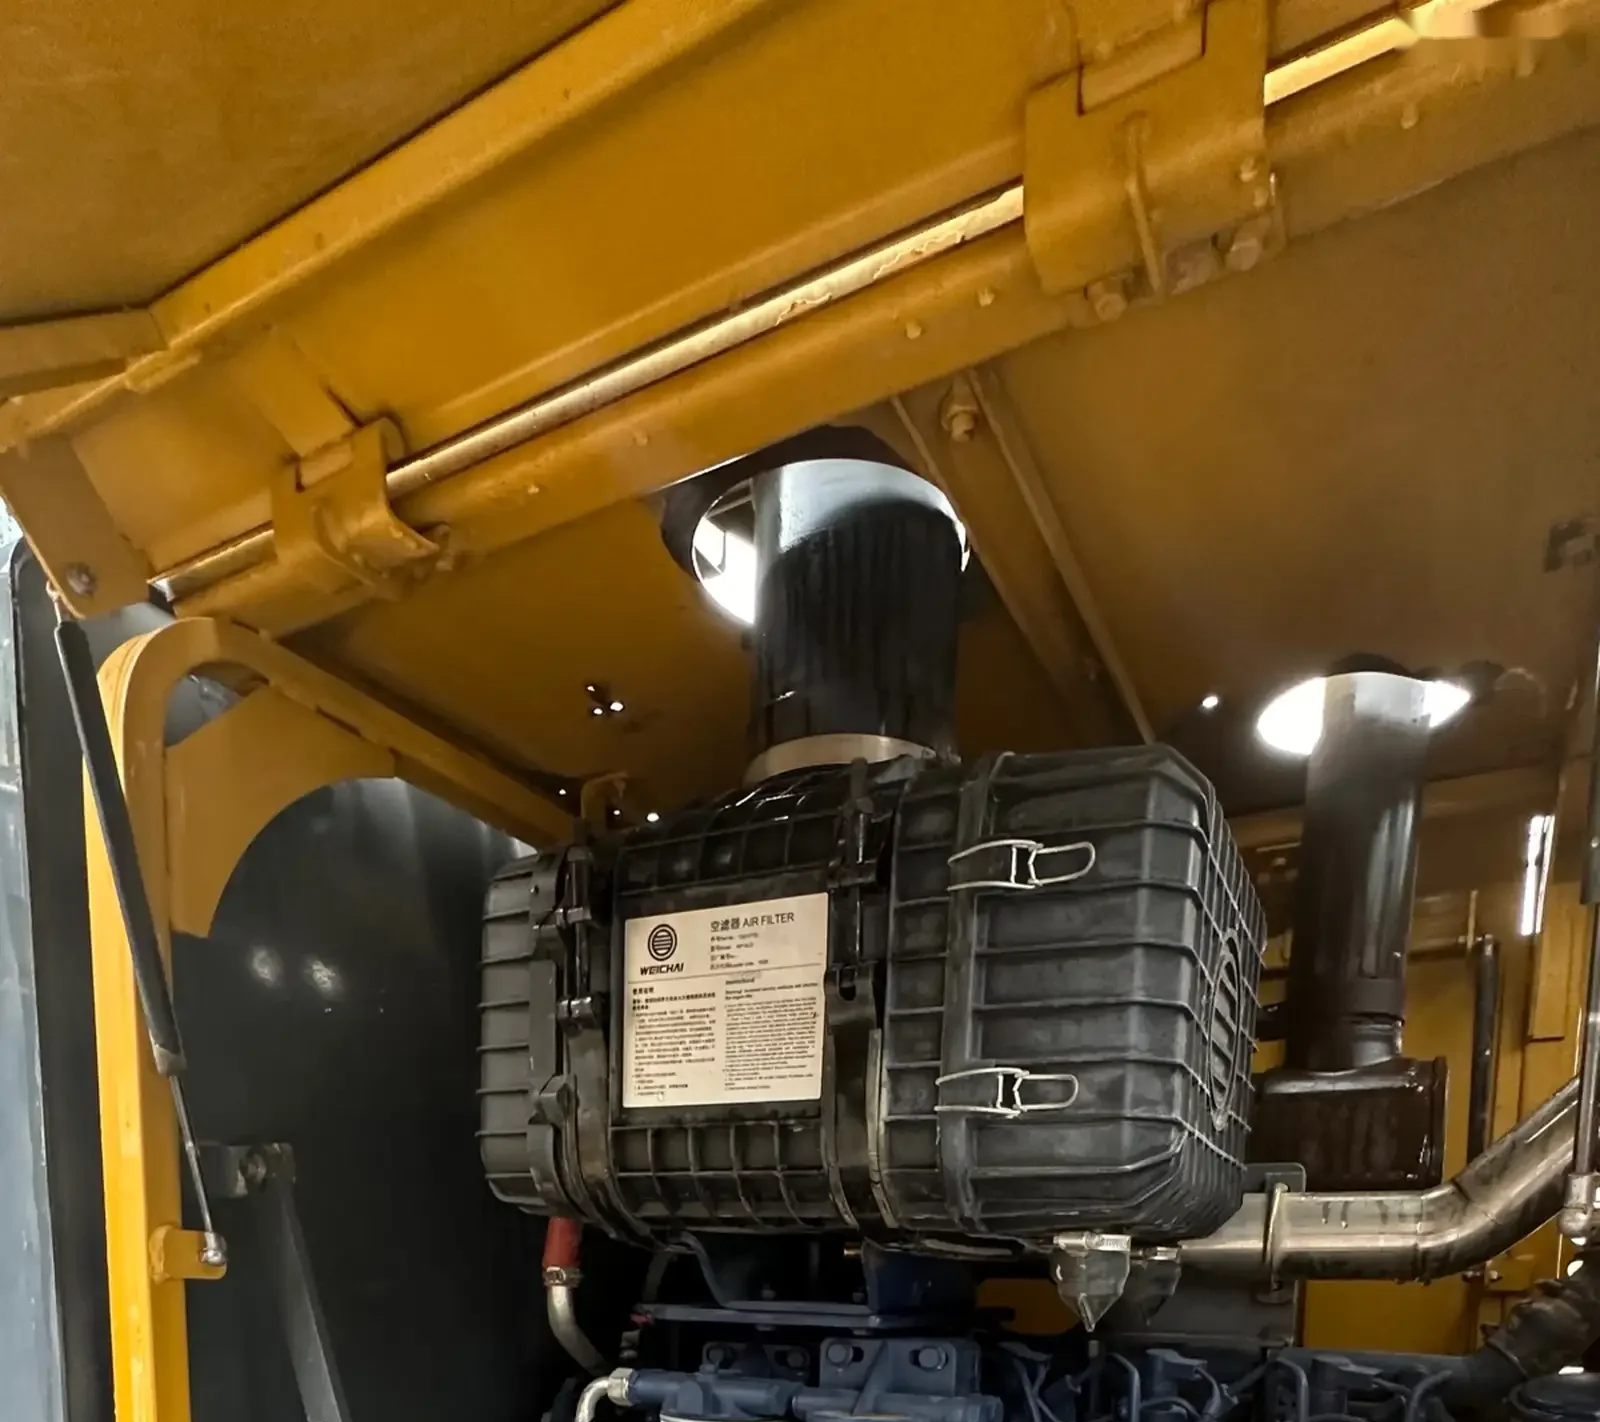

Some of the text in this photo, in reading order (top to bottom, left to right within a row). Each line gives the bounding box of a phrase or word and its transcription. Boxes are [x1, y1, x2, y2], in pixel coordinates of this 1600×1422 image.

[743, 916, 759, 928] AIR
[760, 912, 794, 926] FILTER
[639, 962, 684, 976] WEICHAI
